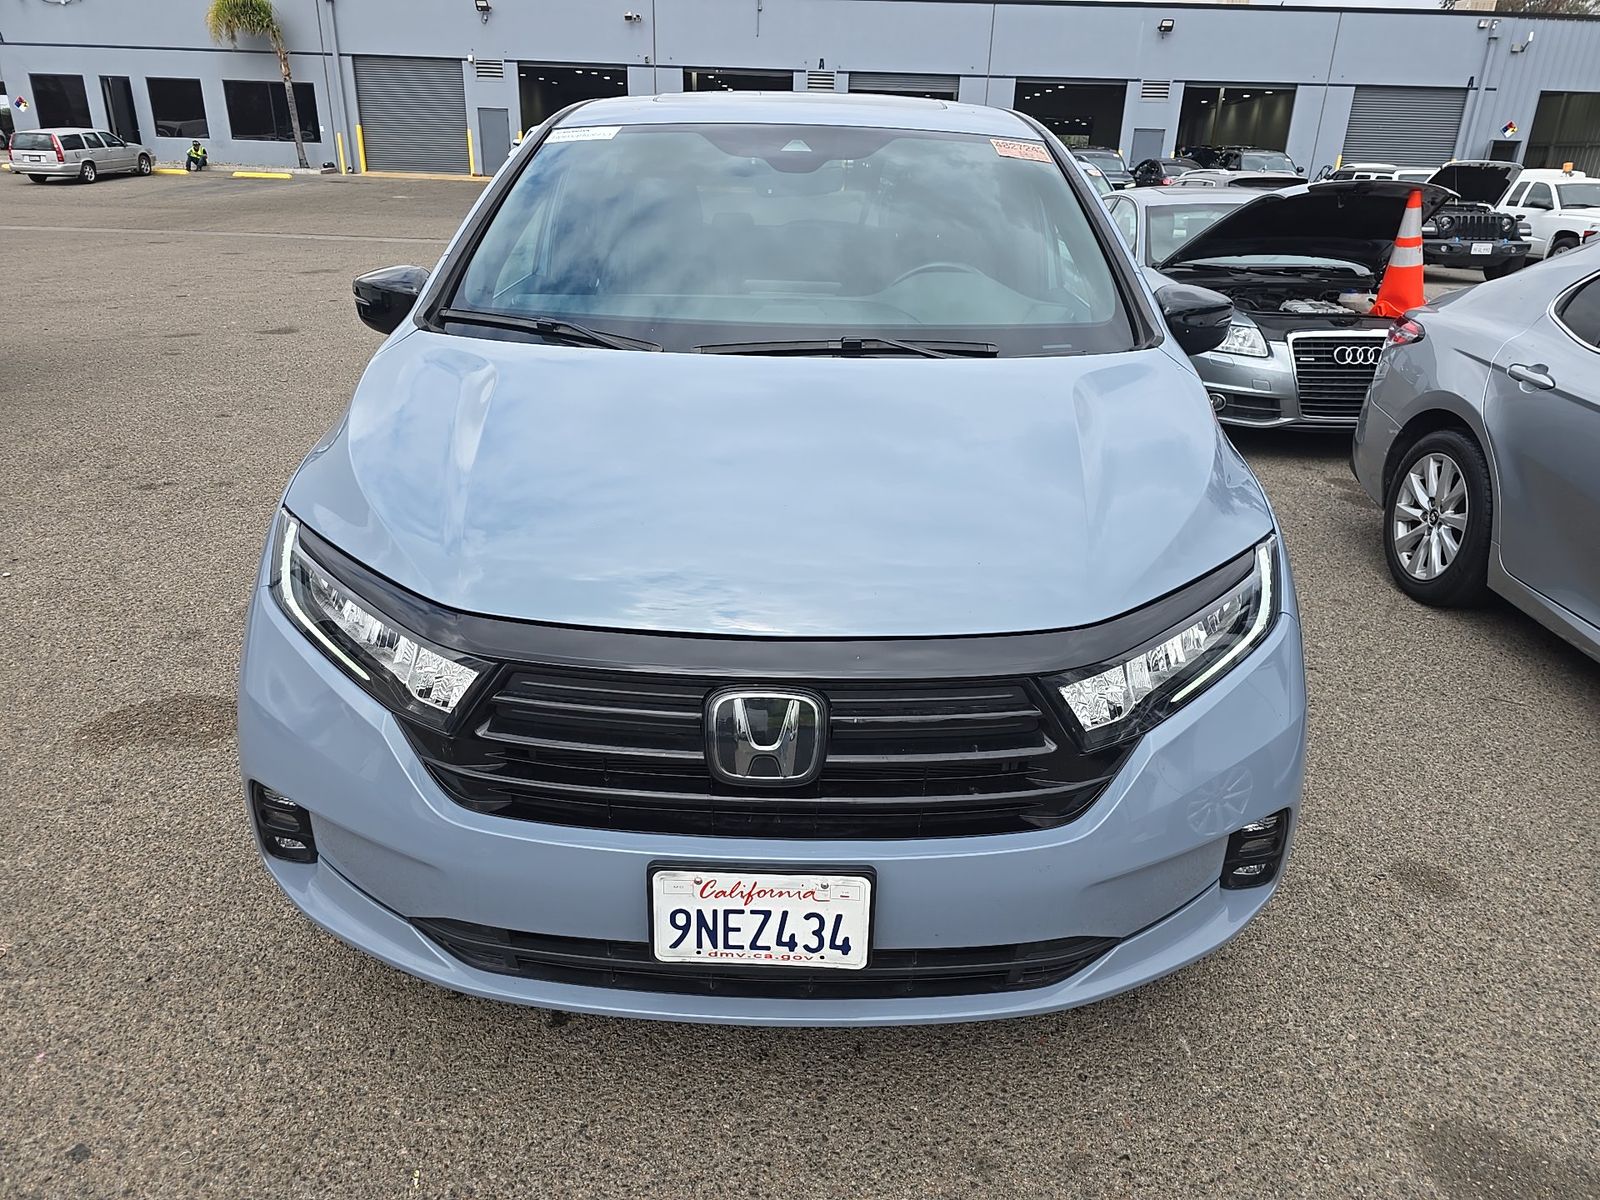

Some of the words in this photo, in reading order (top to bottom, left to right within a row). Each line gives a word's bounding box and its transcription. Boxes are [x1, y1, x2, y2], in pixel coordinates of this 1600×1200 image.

[699, 879, 830, 906] California
[669, 908, 852, 956] 9NEZ434
[708, 951, 814, 961] dmv.ca.gov
